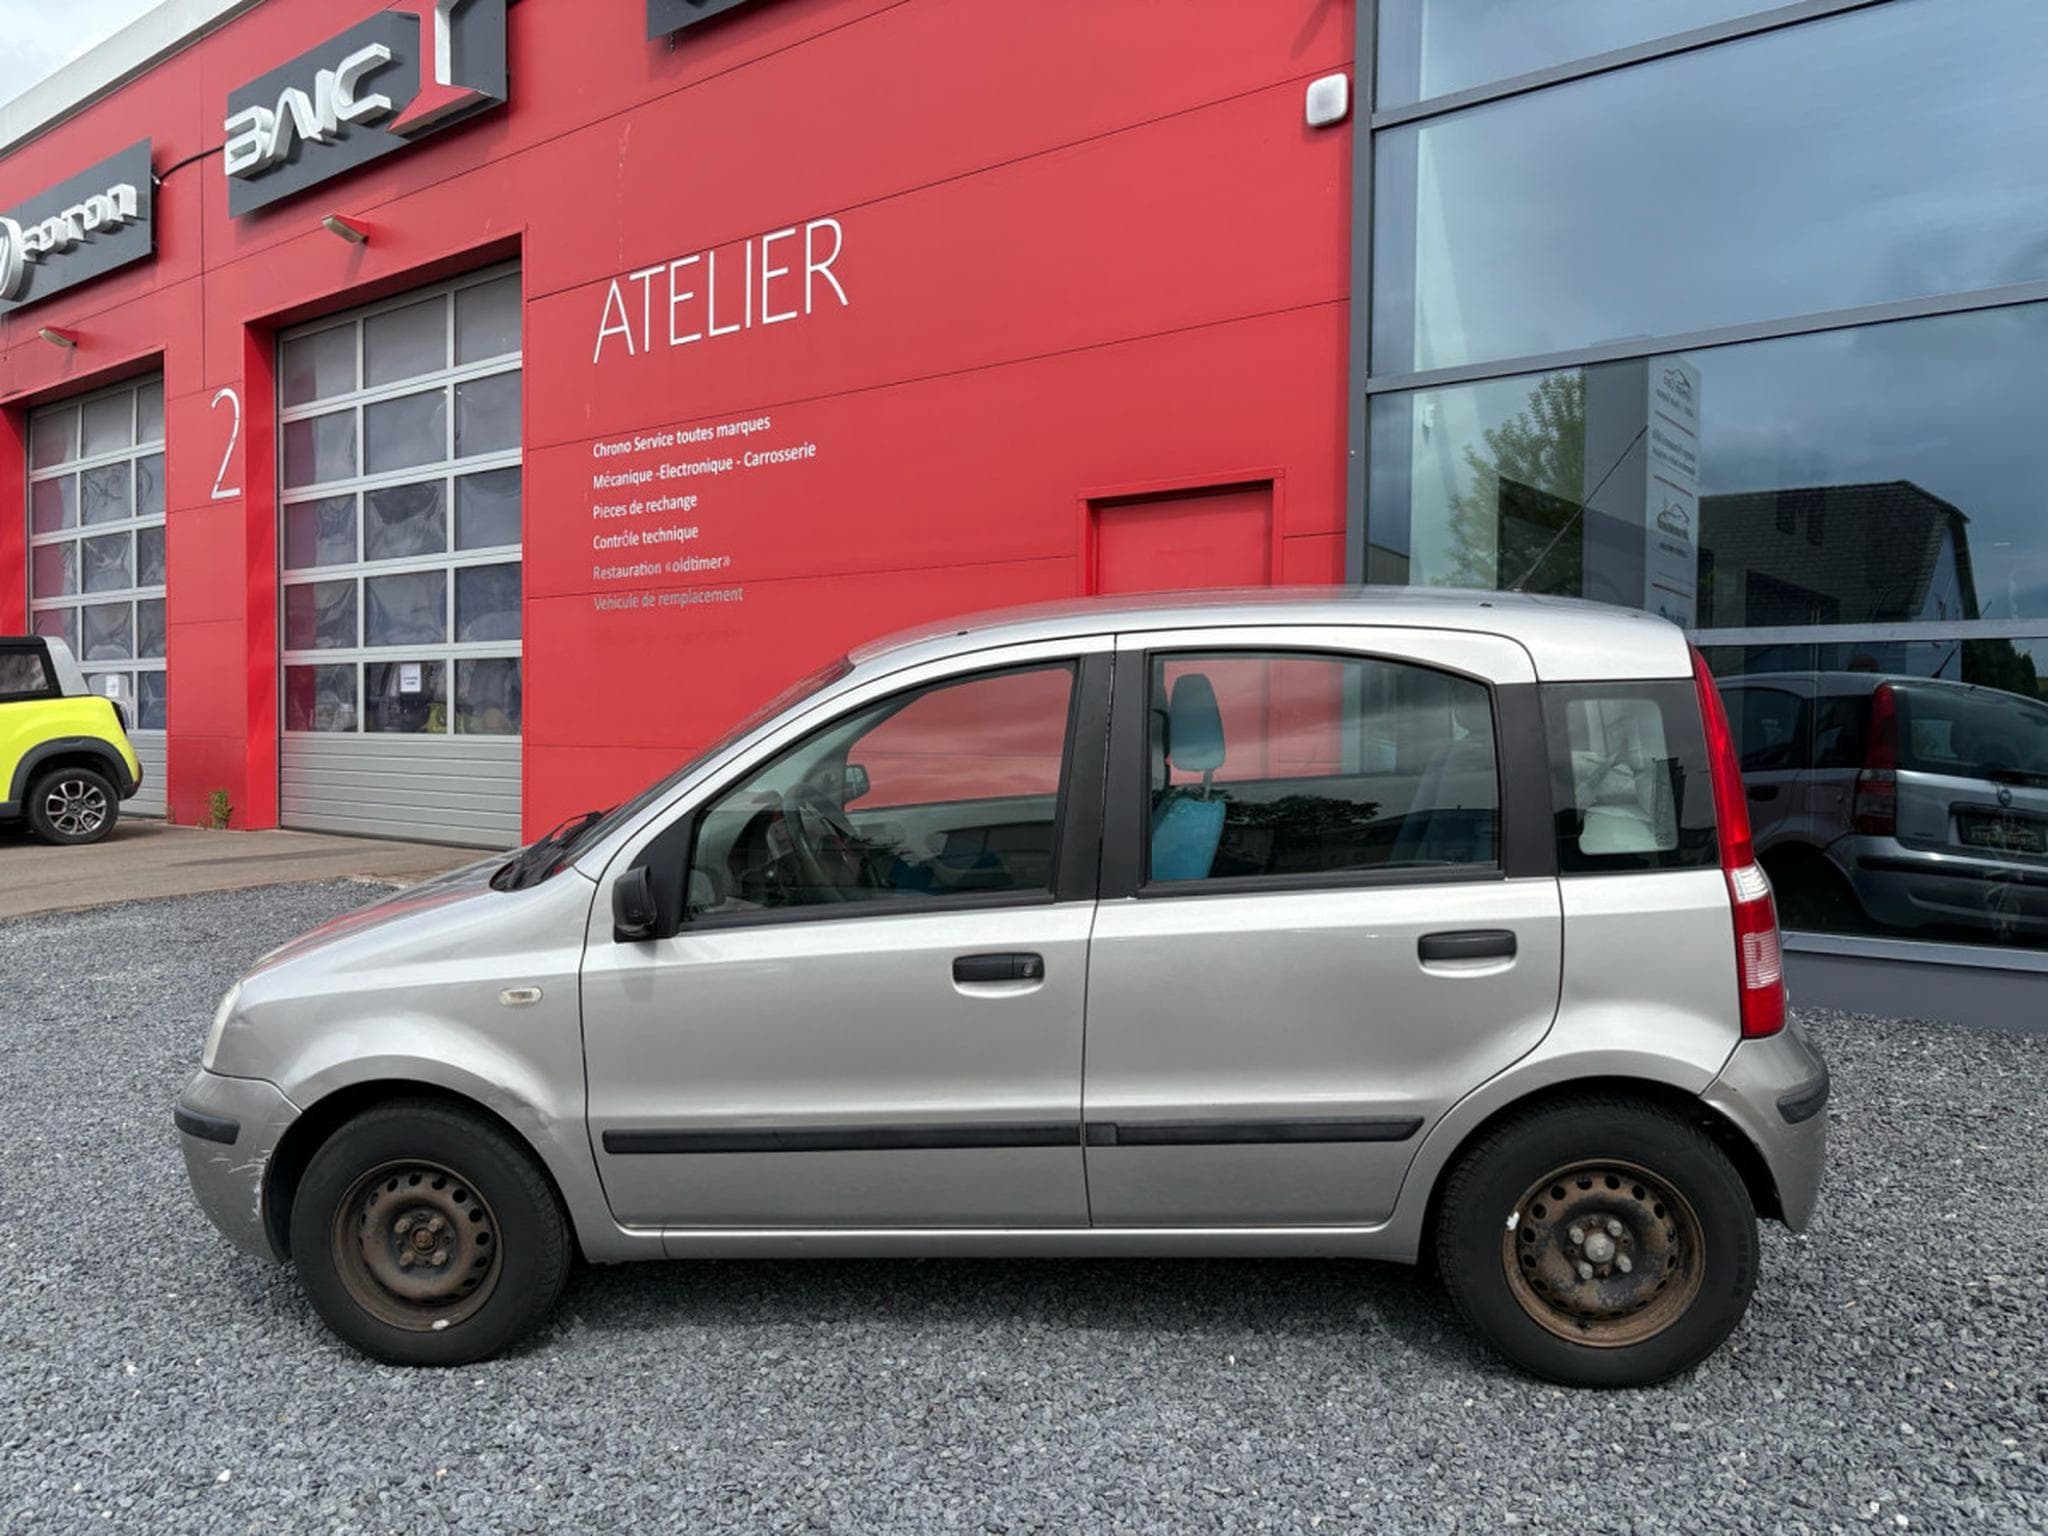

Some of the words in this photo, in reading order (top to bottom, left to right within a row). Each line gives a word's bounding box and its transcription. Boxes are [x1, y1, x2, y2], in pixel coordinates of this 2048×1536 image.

[593, 217, 849, 364] ATELIER
[211, 387, 241, 500] 2
[593, 442, 632, 459] Chrono
[634, 432, 674, 451] Service
[676, 427, 714, 445] toutes
[716, 415, 771, 438] marques
[593, 469, 653, 489] Mécanique
[743, 441, 817, 468] Carrosserie
[629, 500, 643, 515] de
[645, 494, 697, 512] rechange
[593, 530, 639, 551] Contrôle
[642, 525, 699, 544] technique
[593, 560, 661, 581] Restauration
[642, 590, 656, 607] de
[659, 587, 743, 608] remplacement
